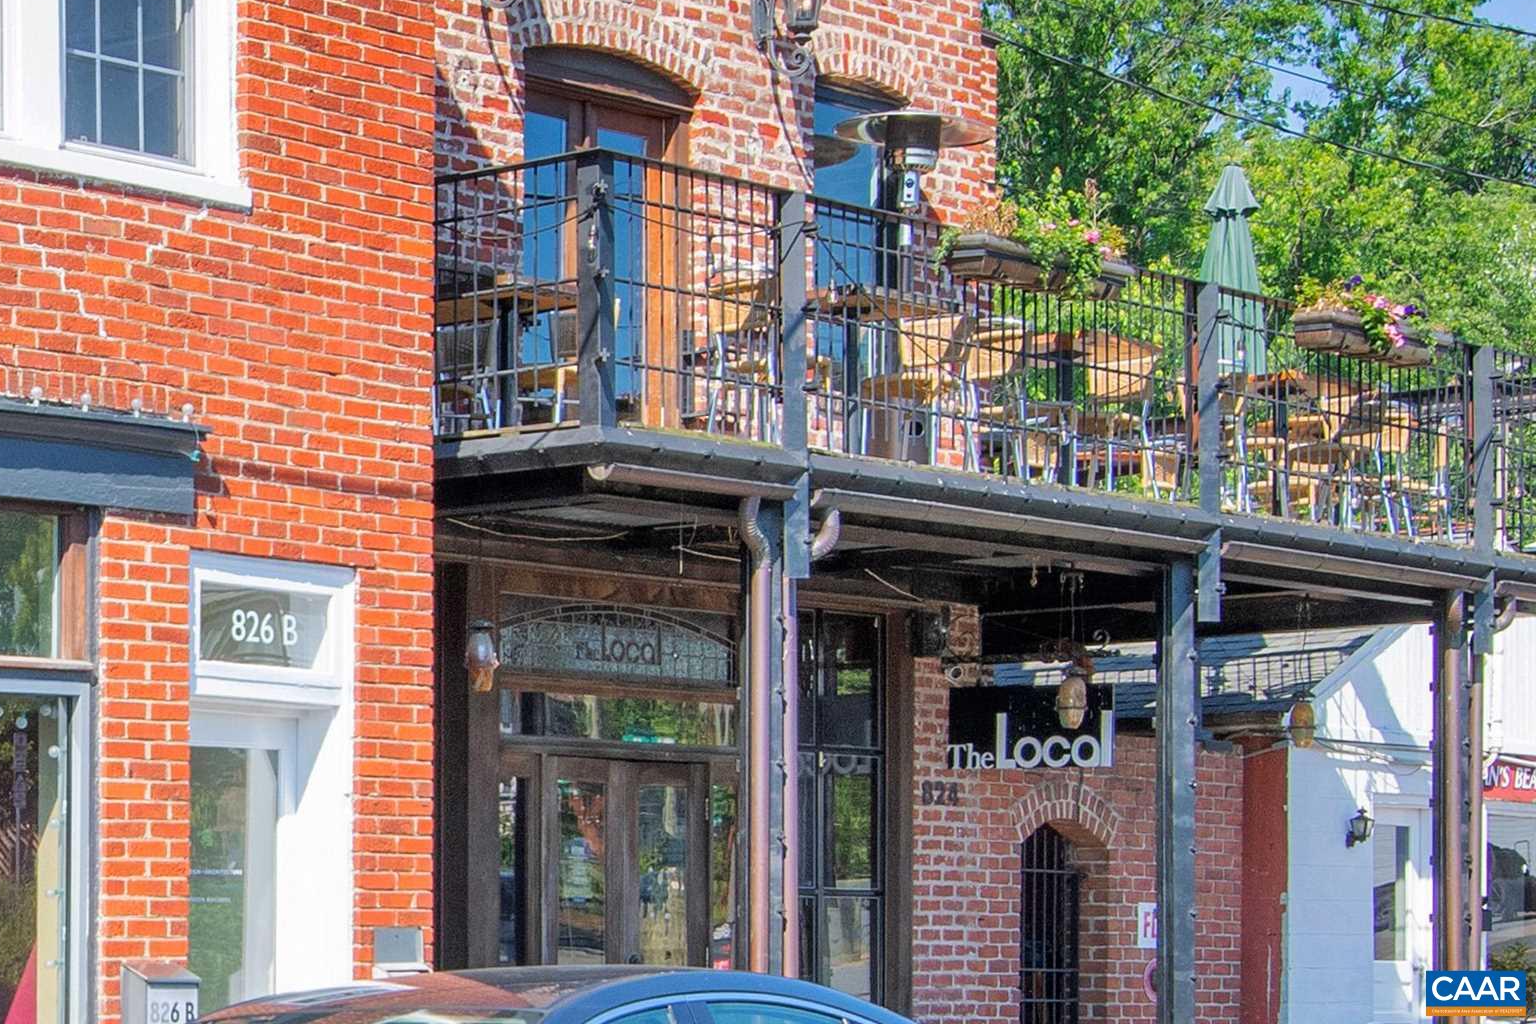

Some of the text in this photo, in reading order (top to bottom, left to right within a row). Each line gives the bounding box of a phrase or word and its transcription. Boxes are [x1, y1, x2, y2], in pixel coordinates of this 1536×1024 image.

[231, 608, 298, 646] 826 B
[946, 709, 1113, 769] The Local
[150, 1002, 195, 1023] 826 B
